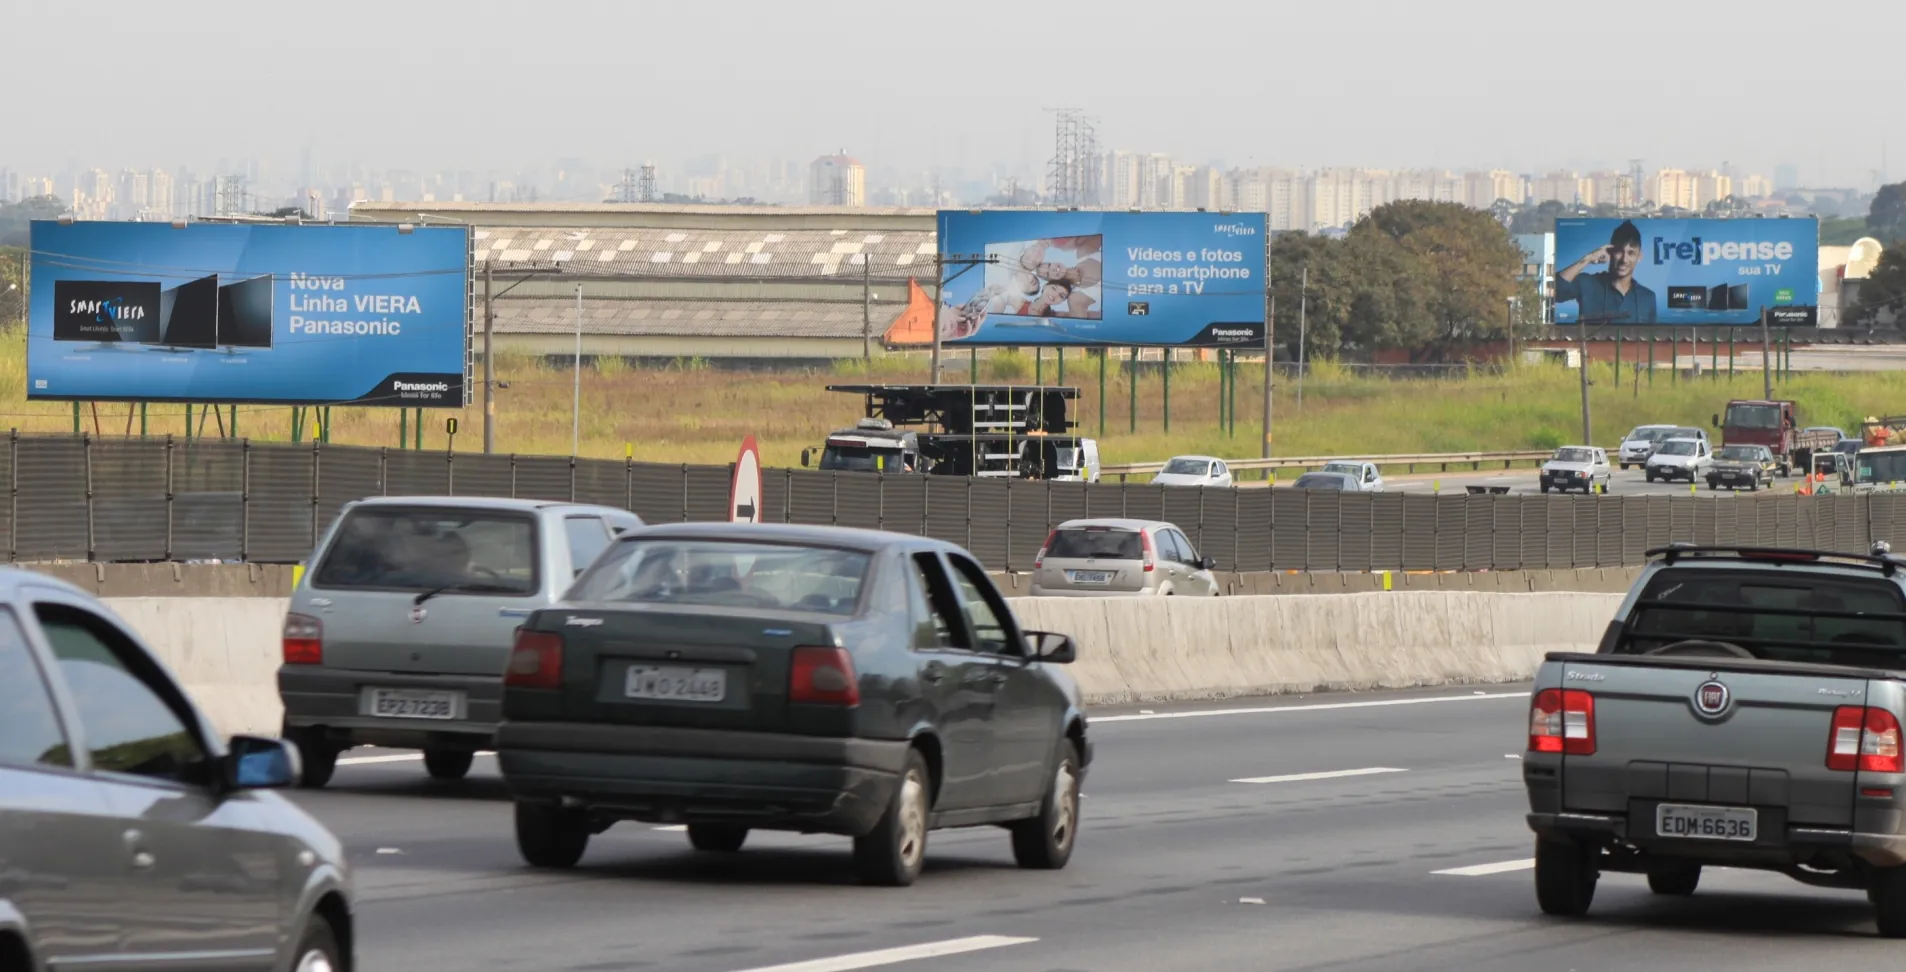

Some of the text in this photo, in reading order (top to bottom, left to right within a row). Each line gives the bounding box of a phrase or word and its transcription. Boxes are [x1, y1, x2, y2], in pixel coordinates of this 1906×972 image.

[1186, 250, 1197, 261] e
[1201, 248, 1243, 262] fotos
[1127, 264, 1250, 281] do smartphone
[1738, 263, 1782, 275] sua TV
[290, 271, 345, 291] Nova
[1127, 281, 1205, 297] para a TV
[290, 294, 422, 314] Linha VIERA
[289, 315, 401, 335] Panasonic
[1212, 328, 1254, 336] Panasonic
[393, 381, 448, 391] Panasonic
